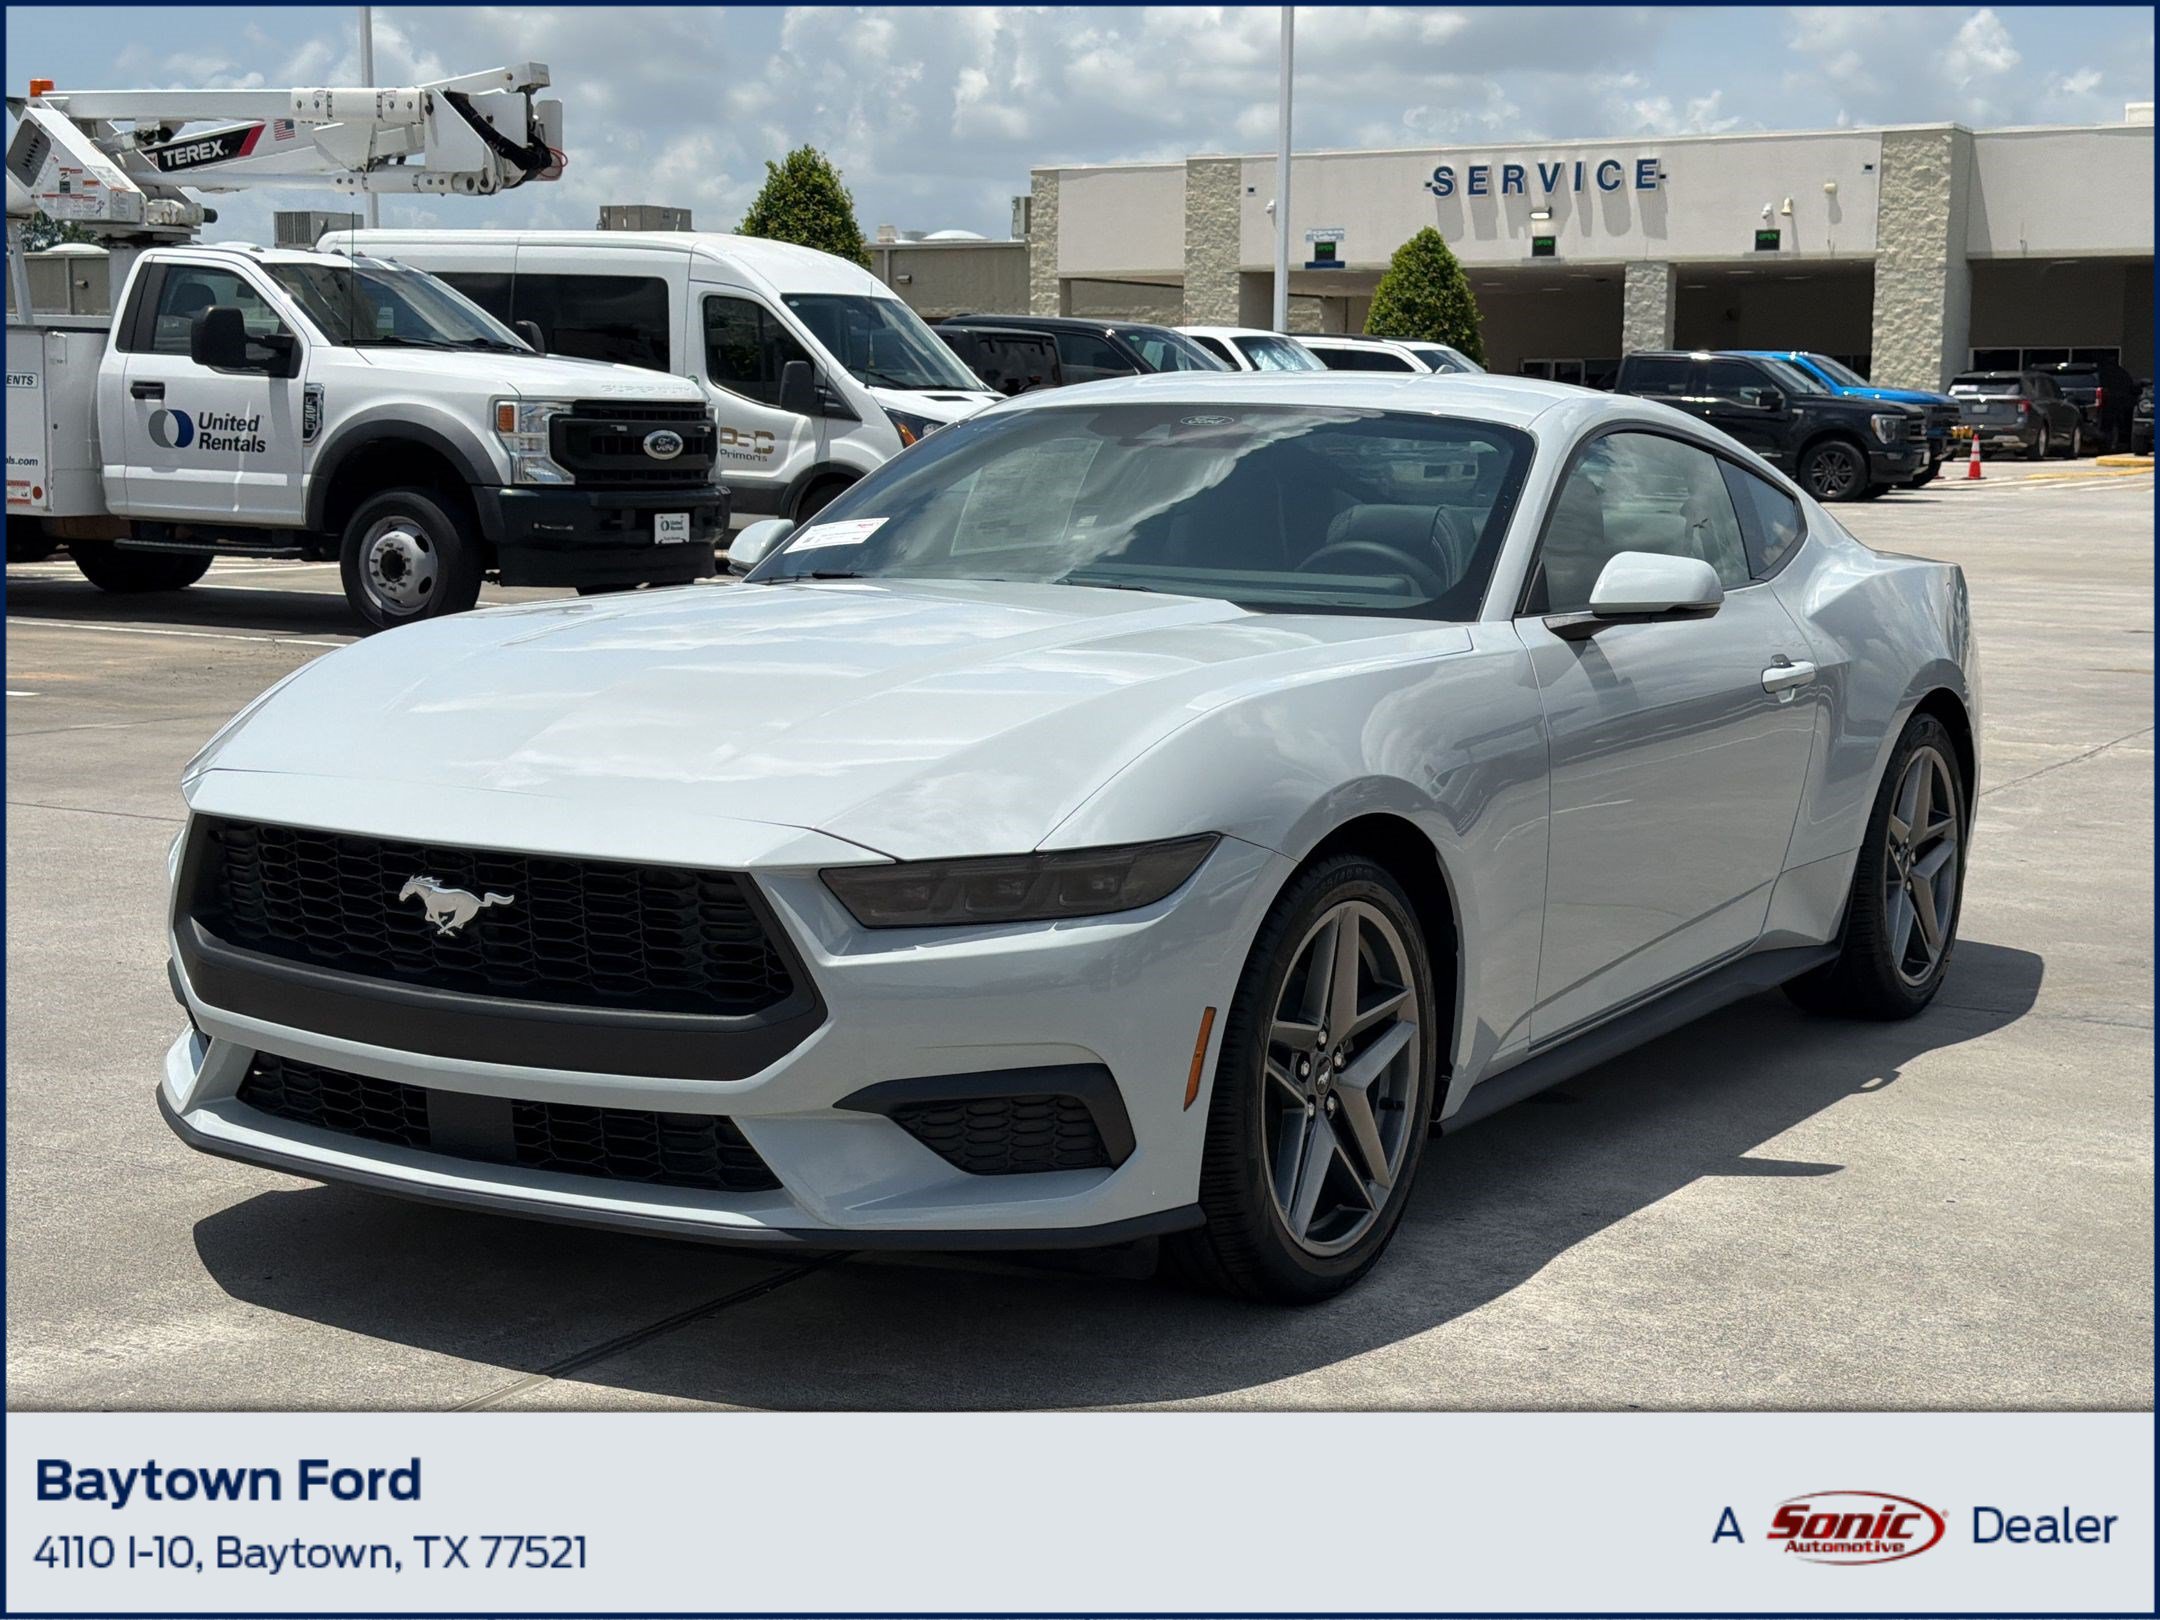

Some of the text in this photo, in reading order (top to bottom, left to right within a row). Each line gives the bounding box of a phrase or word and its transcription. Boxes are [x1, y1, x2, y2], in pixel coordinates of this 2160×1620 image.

[1432, 159, 1658, 196] SERVICE
[198, 411, 260, 432] United
[199, 432, 266, 453] Rentals
